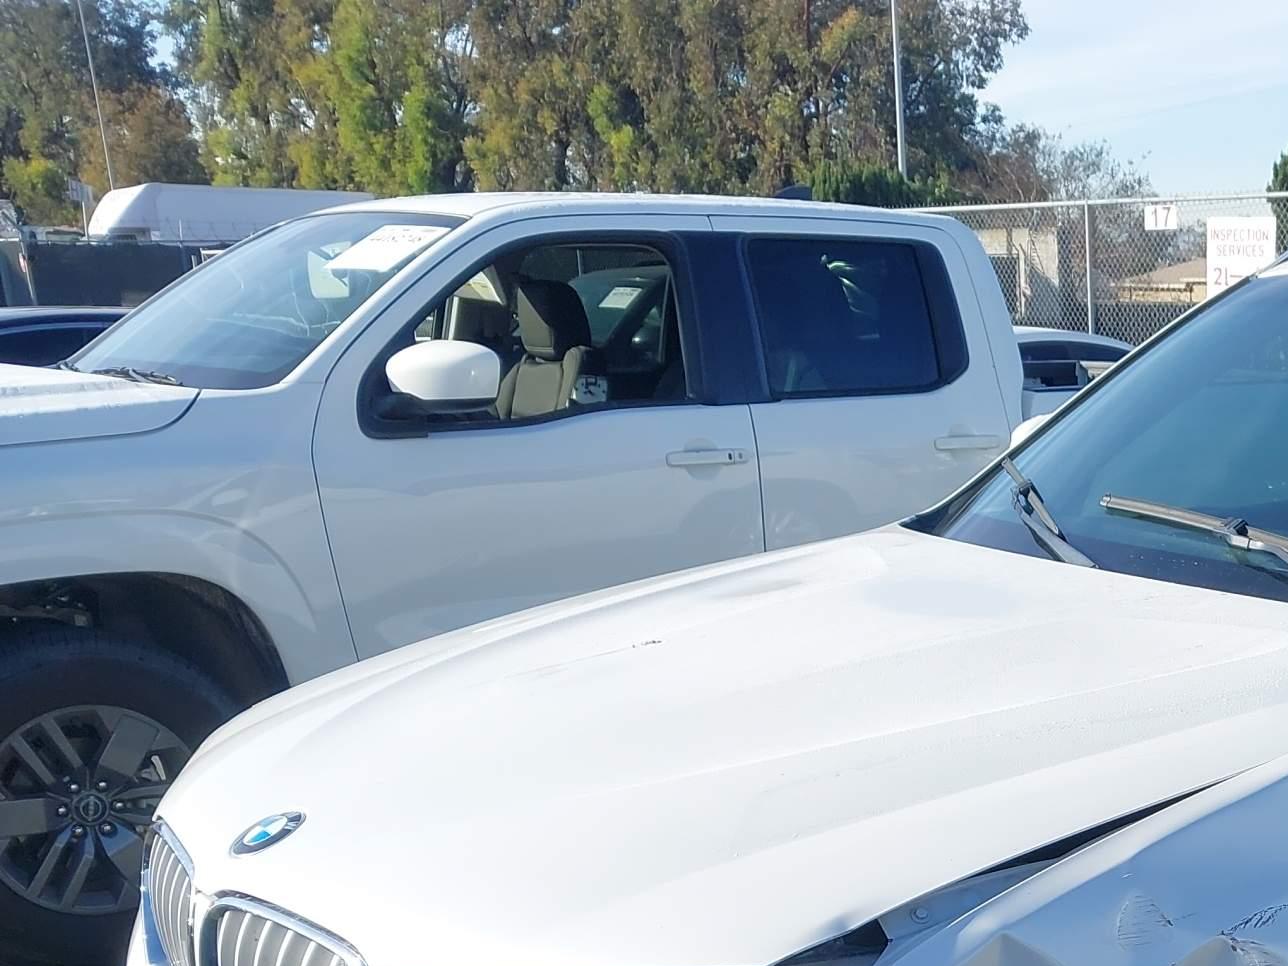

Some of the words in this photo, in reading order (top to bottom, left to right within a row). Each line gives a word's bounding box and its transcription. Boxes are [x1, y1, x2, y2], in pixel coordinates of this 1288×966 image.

[1151, 206, 1171, 228] 17
[1210, 227, 1270, 242] INSPECTION
[1216, 244, 1265, 257] SERVICES
